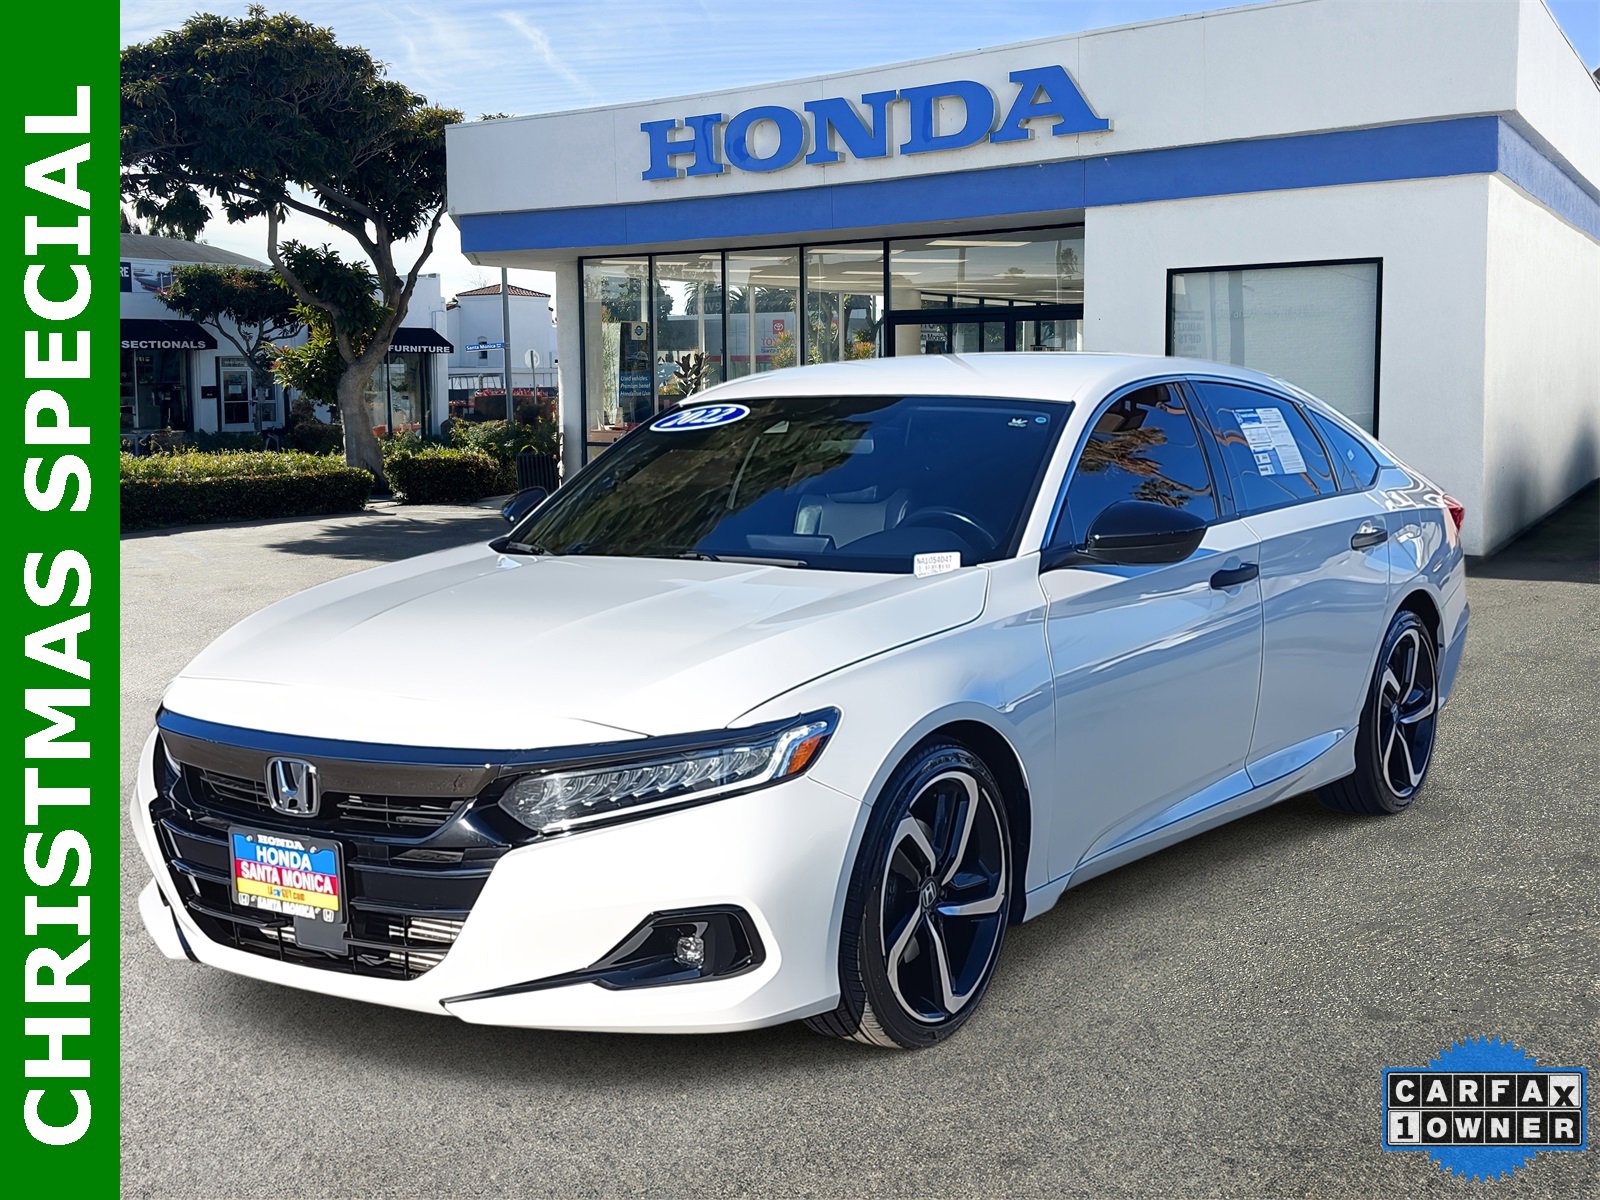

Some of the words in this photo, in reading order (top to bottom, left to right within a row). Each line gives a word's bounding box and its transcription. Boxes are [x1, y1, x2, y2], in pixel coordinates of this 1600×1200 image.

[641, 65, 1114, 181] HONDA
[121, 339, 206, 349] SECTIONALS
[388, 344, 451, 353] FURNITURE
[659, 407, 737, 428] 2022
[257, 834, 305, 851] HONDA
[256, 846, 313, 871] HONDA
[240, 861, 281, 886] SANTA
[282, 868, 334, 895] MONICA
